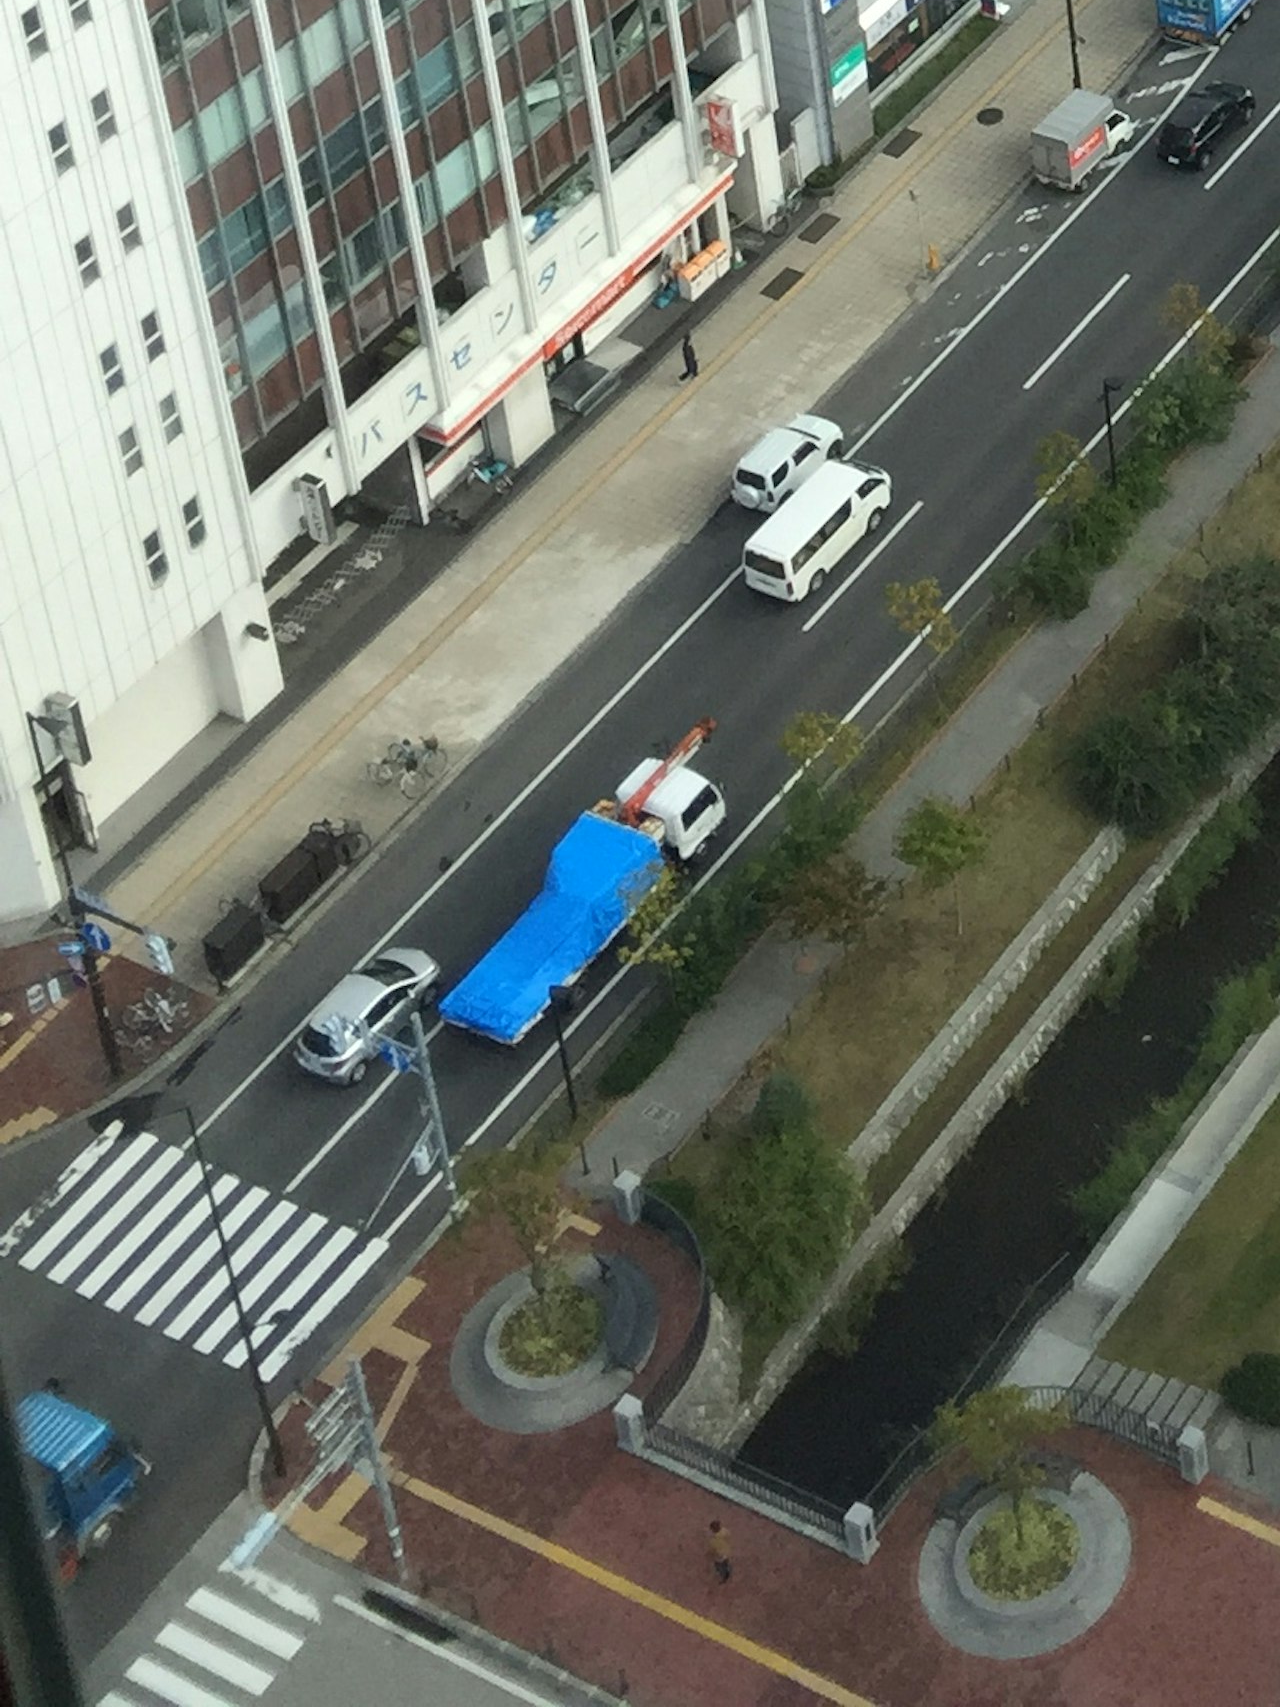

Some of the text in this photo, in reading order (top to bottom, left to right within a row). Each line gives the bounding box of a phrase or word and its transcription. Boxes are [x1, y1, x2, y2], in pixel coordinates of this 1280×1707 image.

[360, 231, 599, 458] バスセンター
